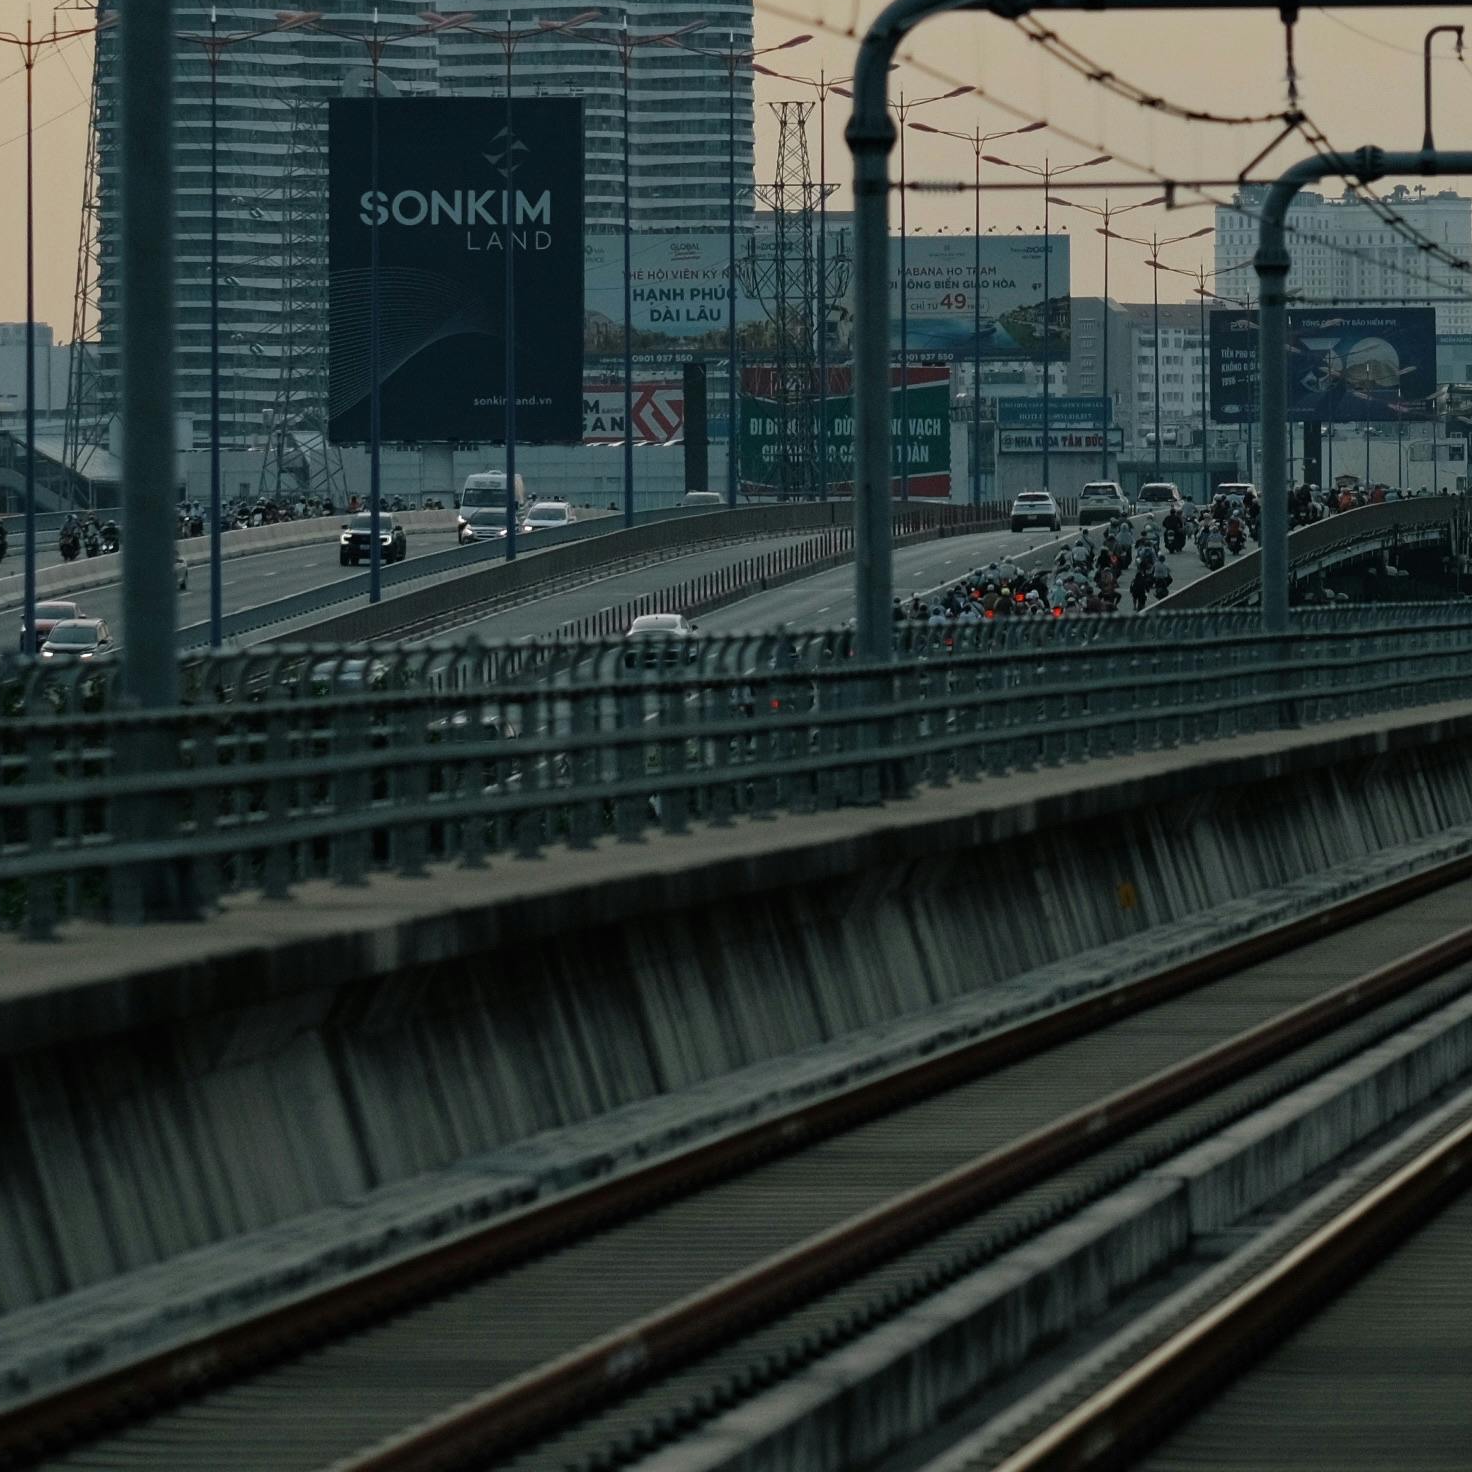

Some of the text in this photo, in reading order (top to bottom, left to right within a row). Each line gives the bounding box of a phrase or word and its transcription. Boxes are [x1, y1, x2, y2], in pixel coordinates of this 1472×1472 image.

[360, 189, 552, 226] SONKIM
[467, 231, 552, 250] LAND
[647, 268, 669, 282] HỘI
[671, 267, 699, 279] VIÊN
[904, 277, 931, 289] ÔNG
[632, 284, 737, 306] HẠNH PHÚC
[940, 293, 967, 310] 49
[649, 305, 721, 322] DÀI LÂU
[656, 354, 673, 362] 937
[898, 353, 919, 361] 001
[473, 395, 552, 406] sonkiand.vn
[909, 417, 942, 439] VẠCH
[1035, 435, 1059, 448] KOA
